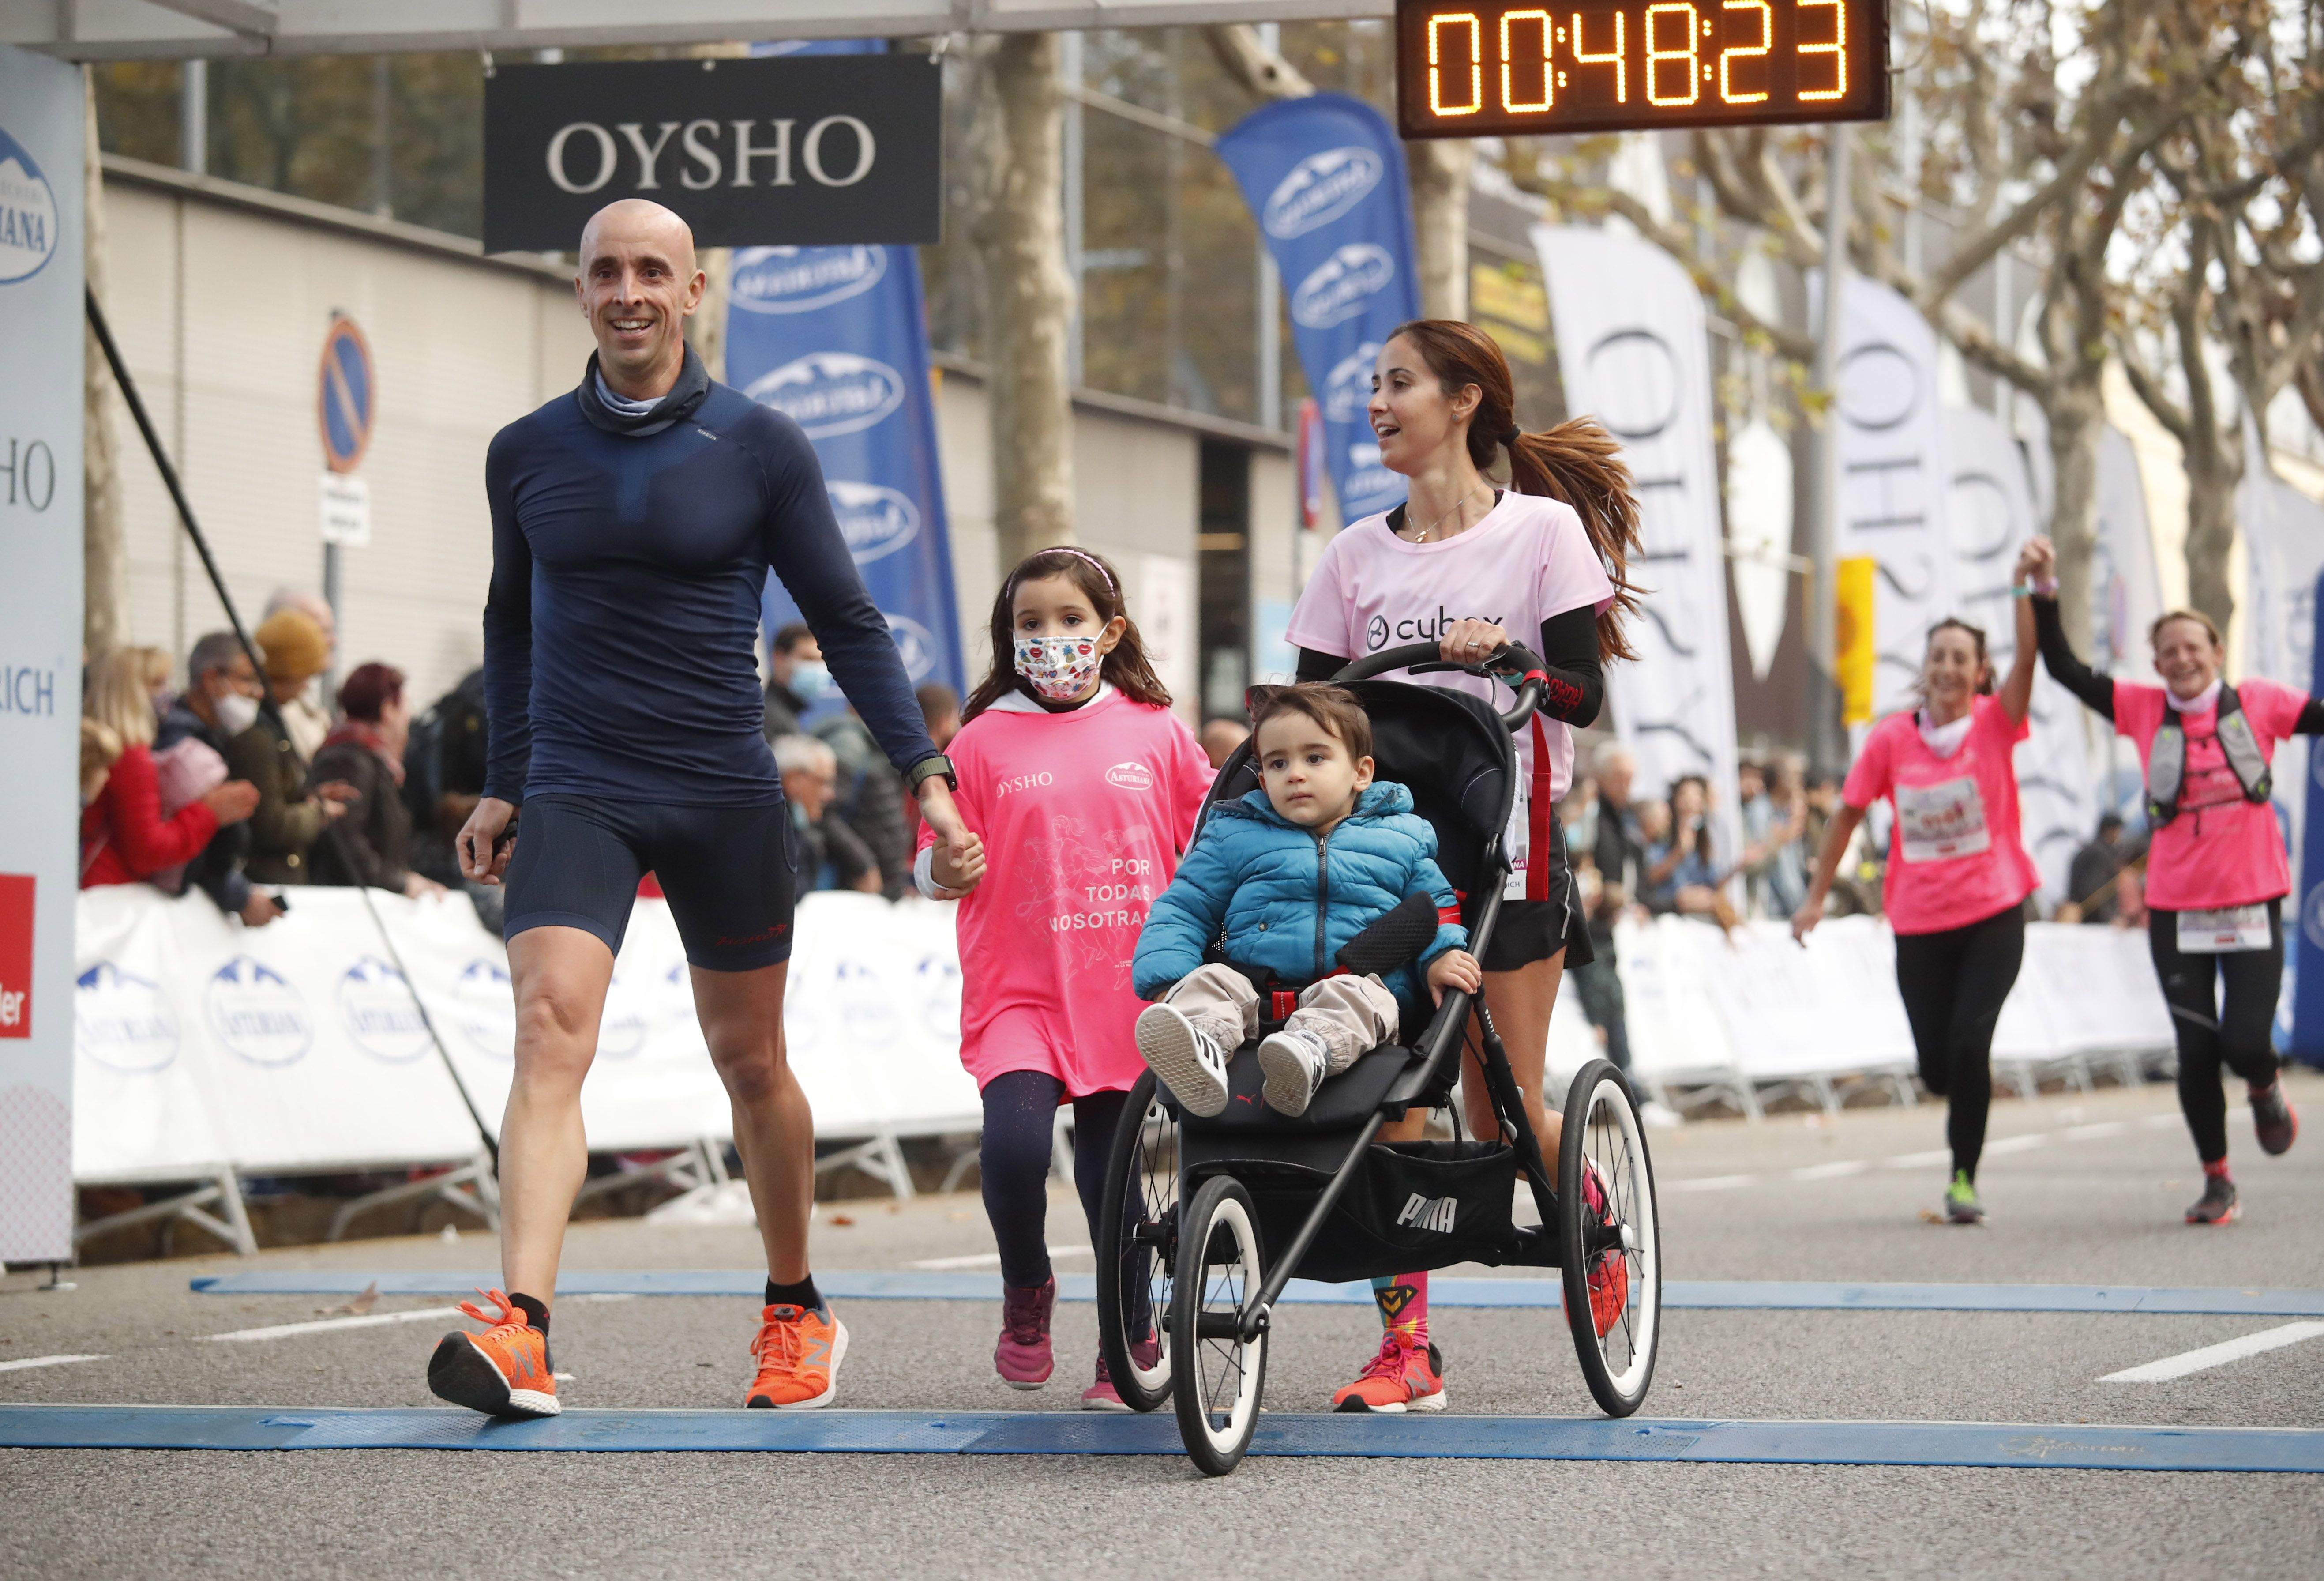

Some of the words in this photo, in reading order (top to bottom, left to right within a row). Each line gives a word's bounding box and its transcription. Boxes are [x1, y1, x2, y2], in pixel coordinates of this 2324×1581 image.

[1429, 0, 1847, 116] 00:48:23
[546, 114, 876, 195] OYSHO
[1397, 606, 1503, 641] cyb
[0, 665, 53, 714] ICH
[1110, 771, 1150, 785] ASTURIANA
[1112, 858, 1150, 876] POR
[1085, 884, 1150, 902] TODAS
